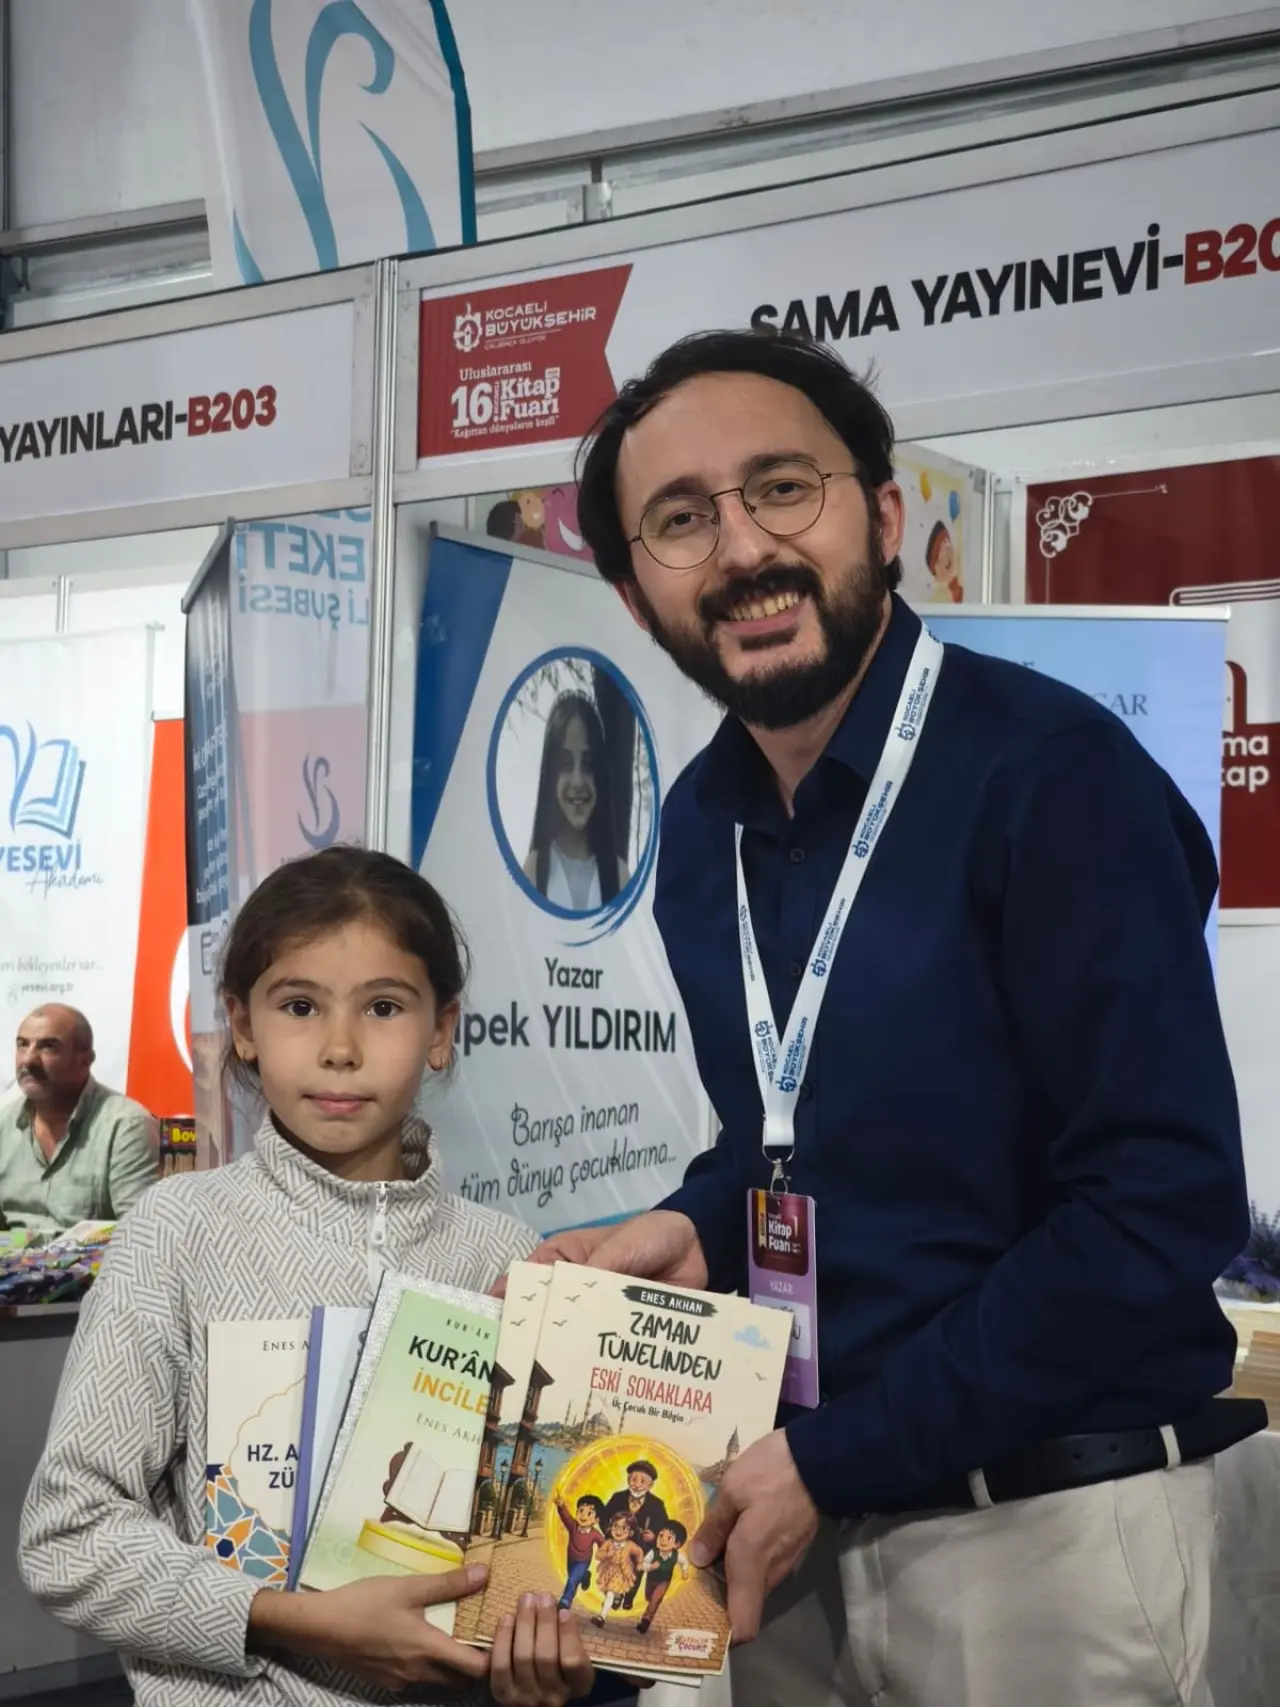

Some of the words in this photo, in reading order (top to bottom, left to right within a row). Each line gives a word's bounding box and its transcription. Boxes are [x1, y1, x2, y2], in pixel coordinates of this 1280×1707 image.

[751, 285, 899, 344] SAMA
[460, 361, 532, 381] Uluslararası
[500, 376, 560, 400] Kitap
[451, 382, 493, 428] 16
[500, 398, 559, 421] Fuarı
[0, 384, 277, 463] YAYINLARI-B203
[544, 957, 604, 990] Yazar
[542, 1004, 676, 1054] YILDIRIM
[511, 1102, 574, 1148] Barışa
[580, 1102, 639, 1134] inanan
[460, 1174, 500, 1204] tüm
[507, 1157, 564, 1209] dünya
[768, 1219, 792, 1240] Kitap
[640, 1291, 666, 1306] ENES
[668, 1297, 704, 1314] AKHAN
[630, 1311, 701, 1346] ZAMAN
[263, 1340, 295, 1352] ENES
[598, 1331, 722, 1381] TÜNELİNDEN
[590, 1366, 623, 1393] ESKİ
[626, 1374, 713, 1415] SOKAKLARA
[416, 1412, 448, 1433] ENES
[648, 1406, 661, 1418] Bir
[247, 1444, 279, 1463] HZ.
[268, 1466, 295, 1489] ZÜ
